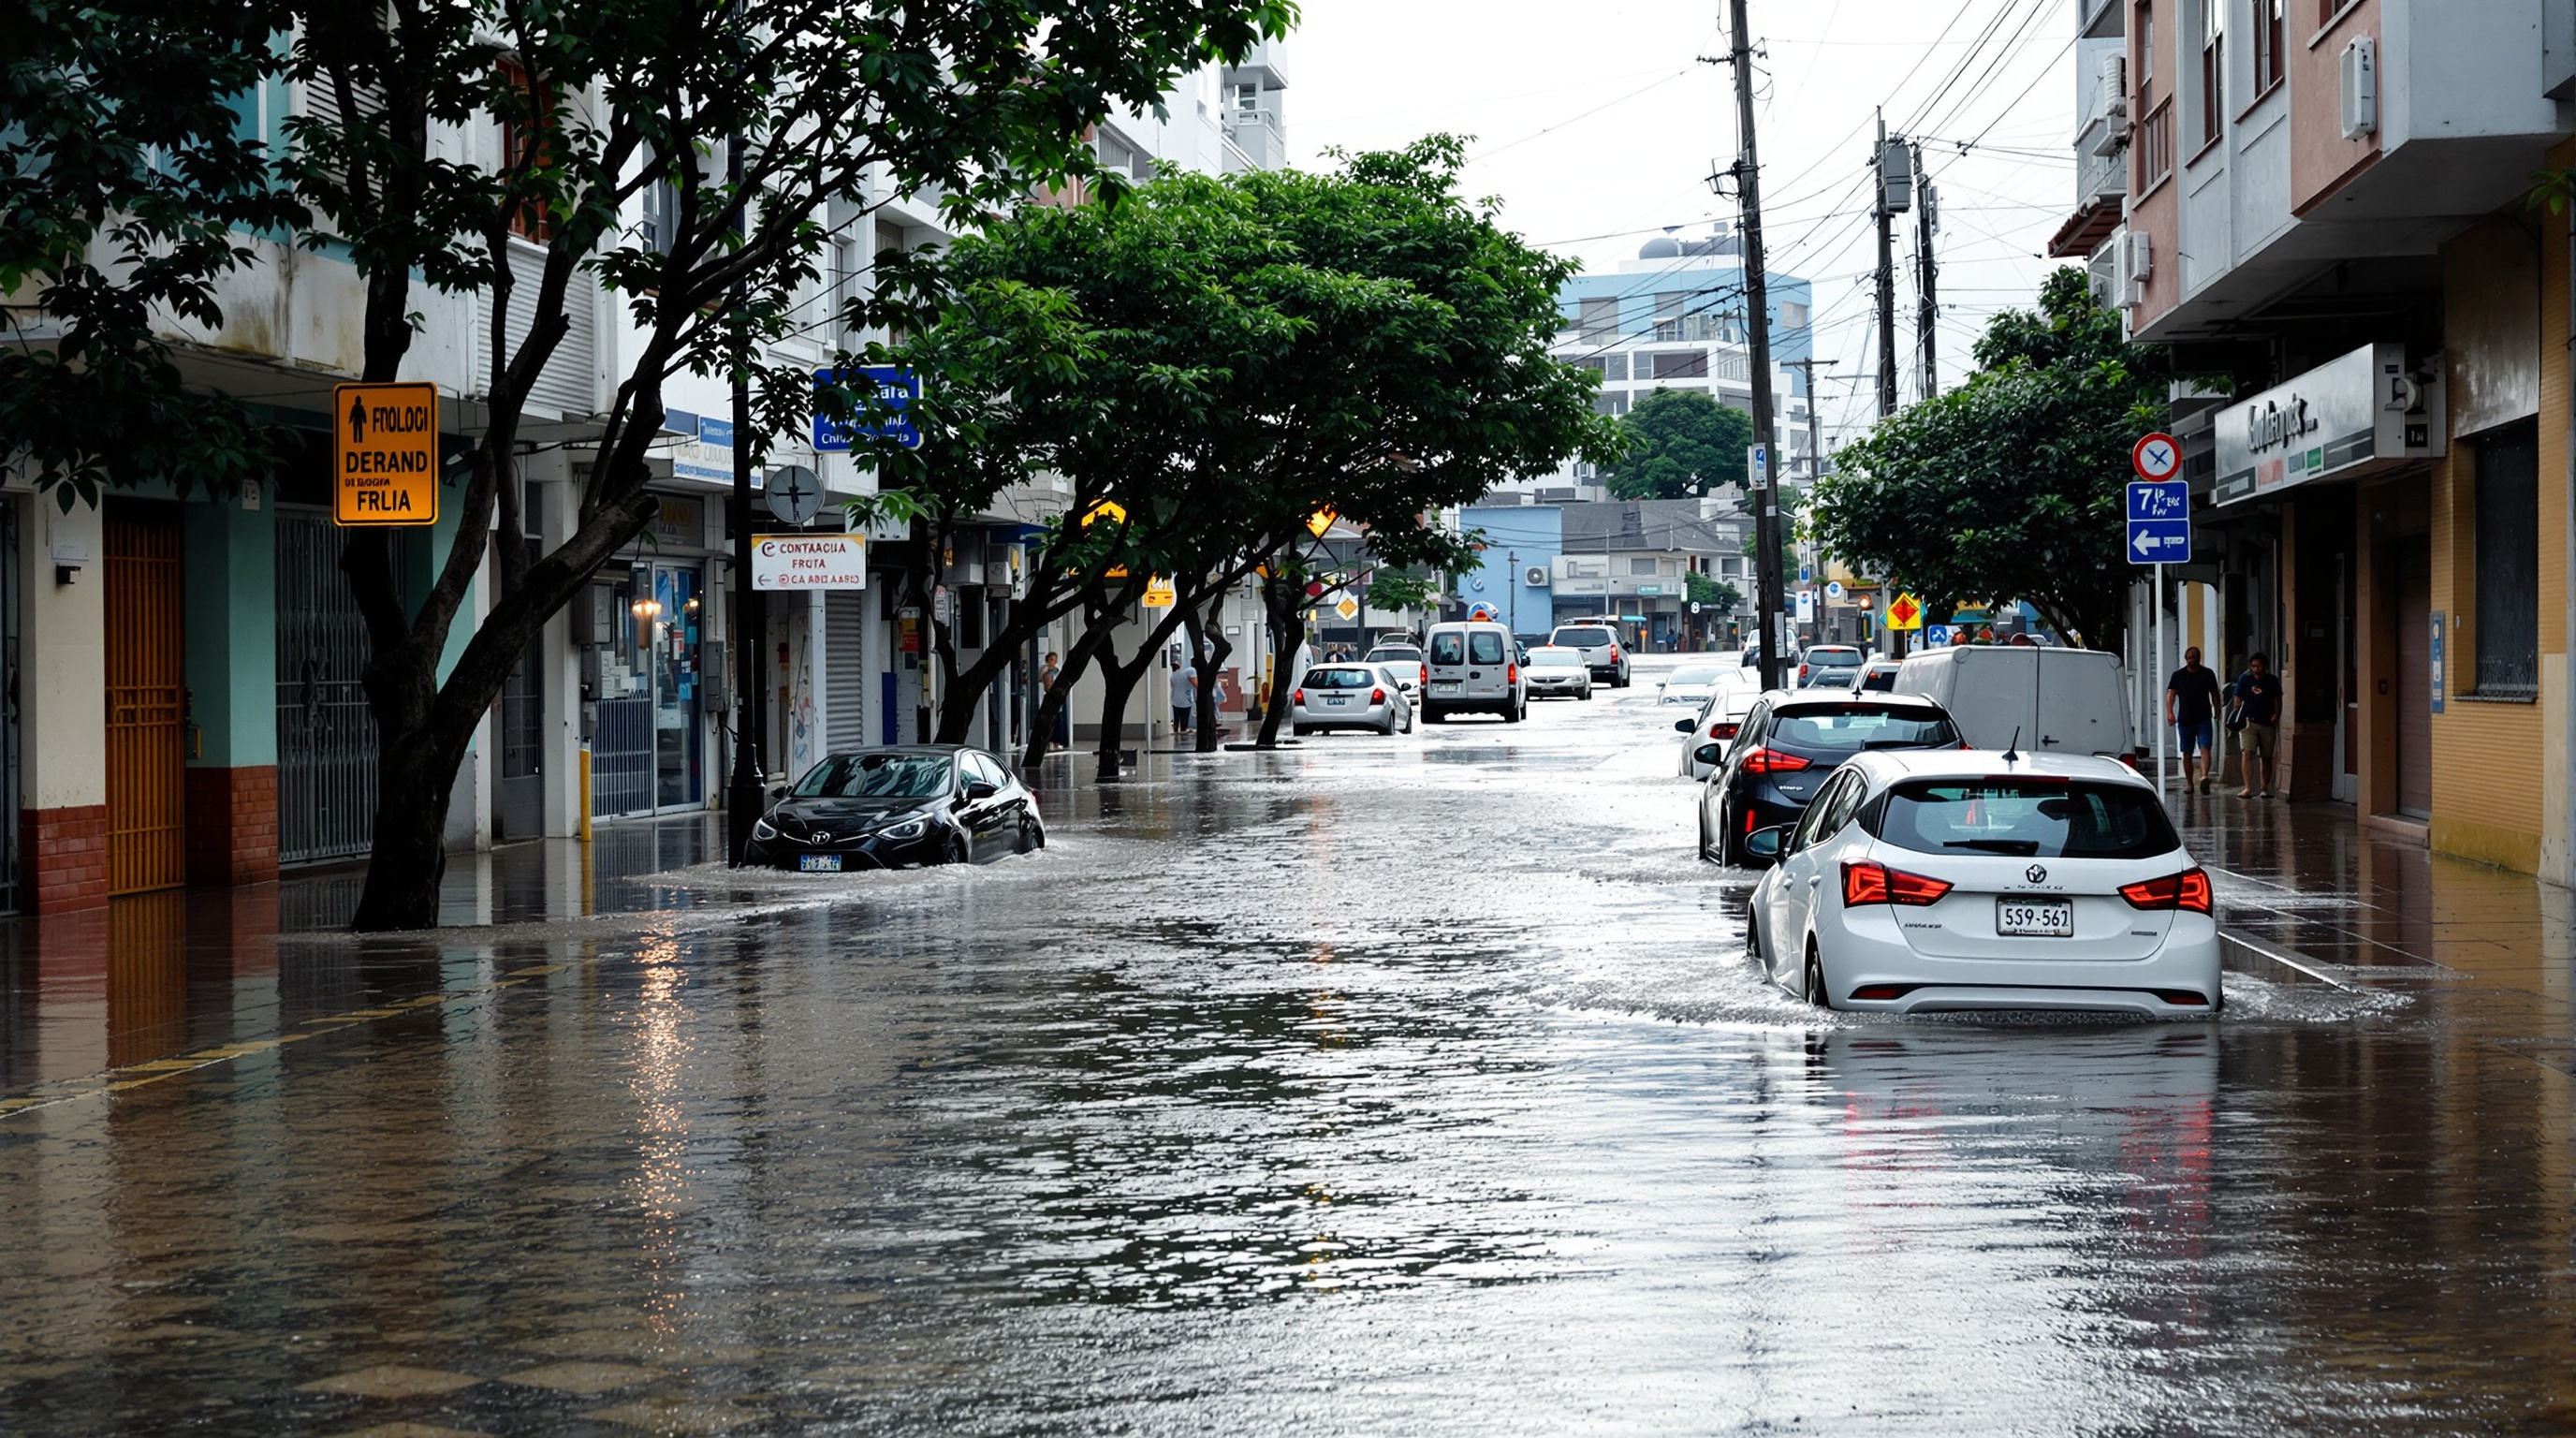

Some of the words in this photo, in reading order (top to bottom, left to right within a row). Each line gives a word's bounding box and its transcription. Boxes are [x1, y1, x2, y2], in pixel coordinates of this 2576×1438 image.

[346, 451, 428, 473] DERAND
[358, 490, 412, 511] FRLIA
[2138, 488, 2153, 510] 7
